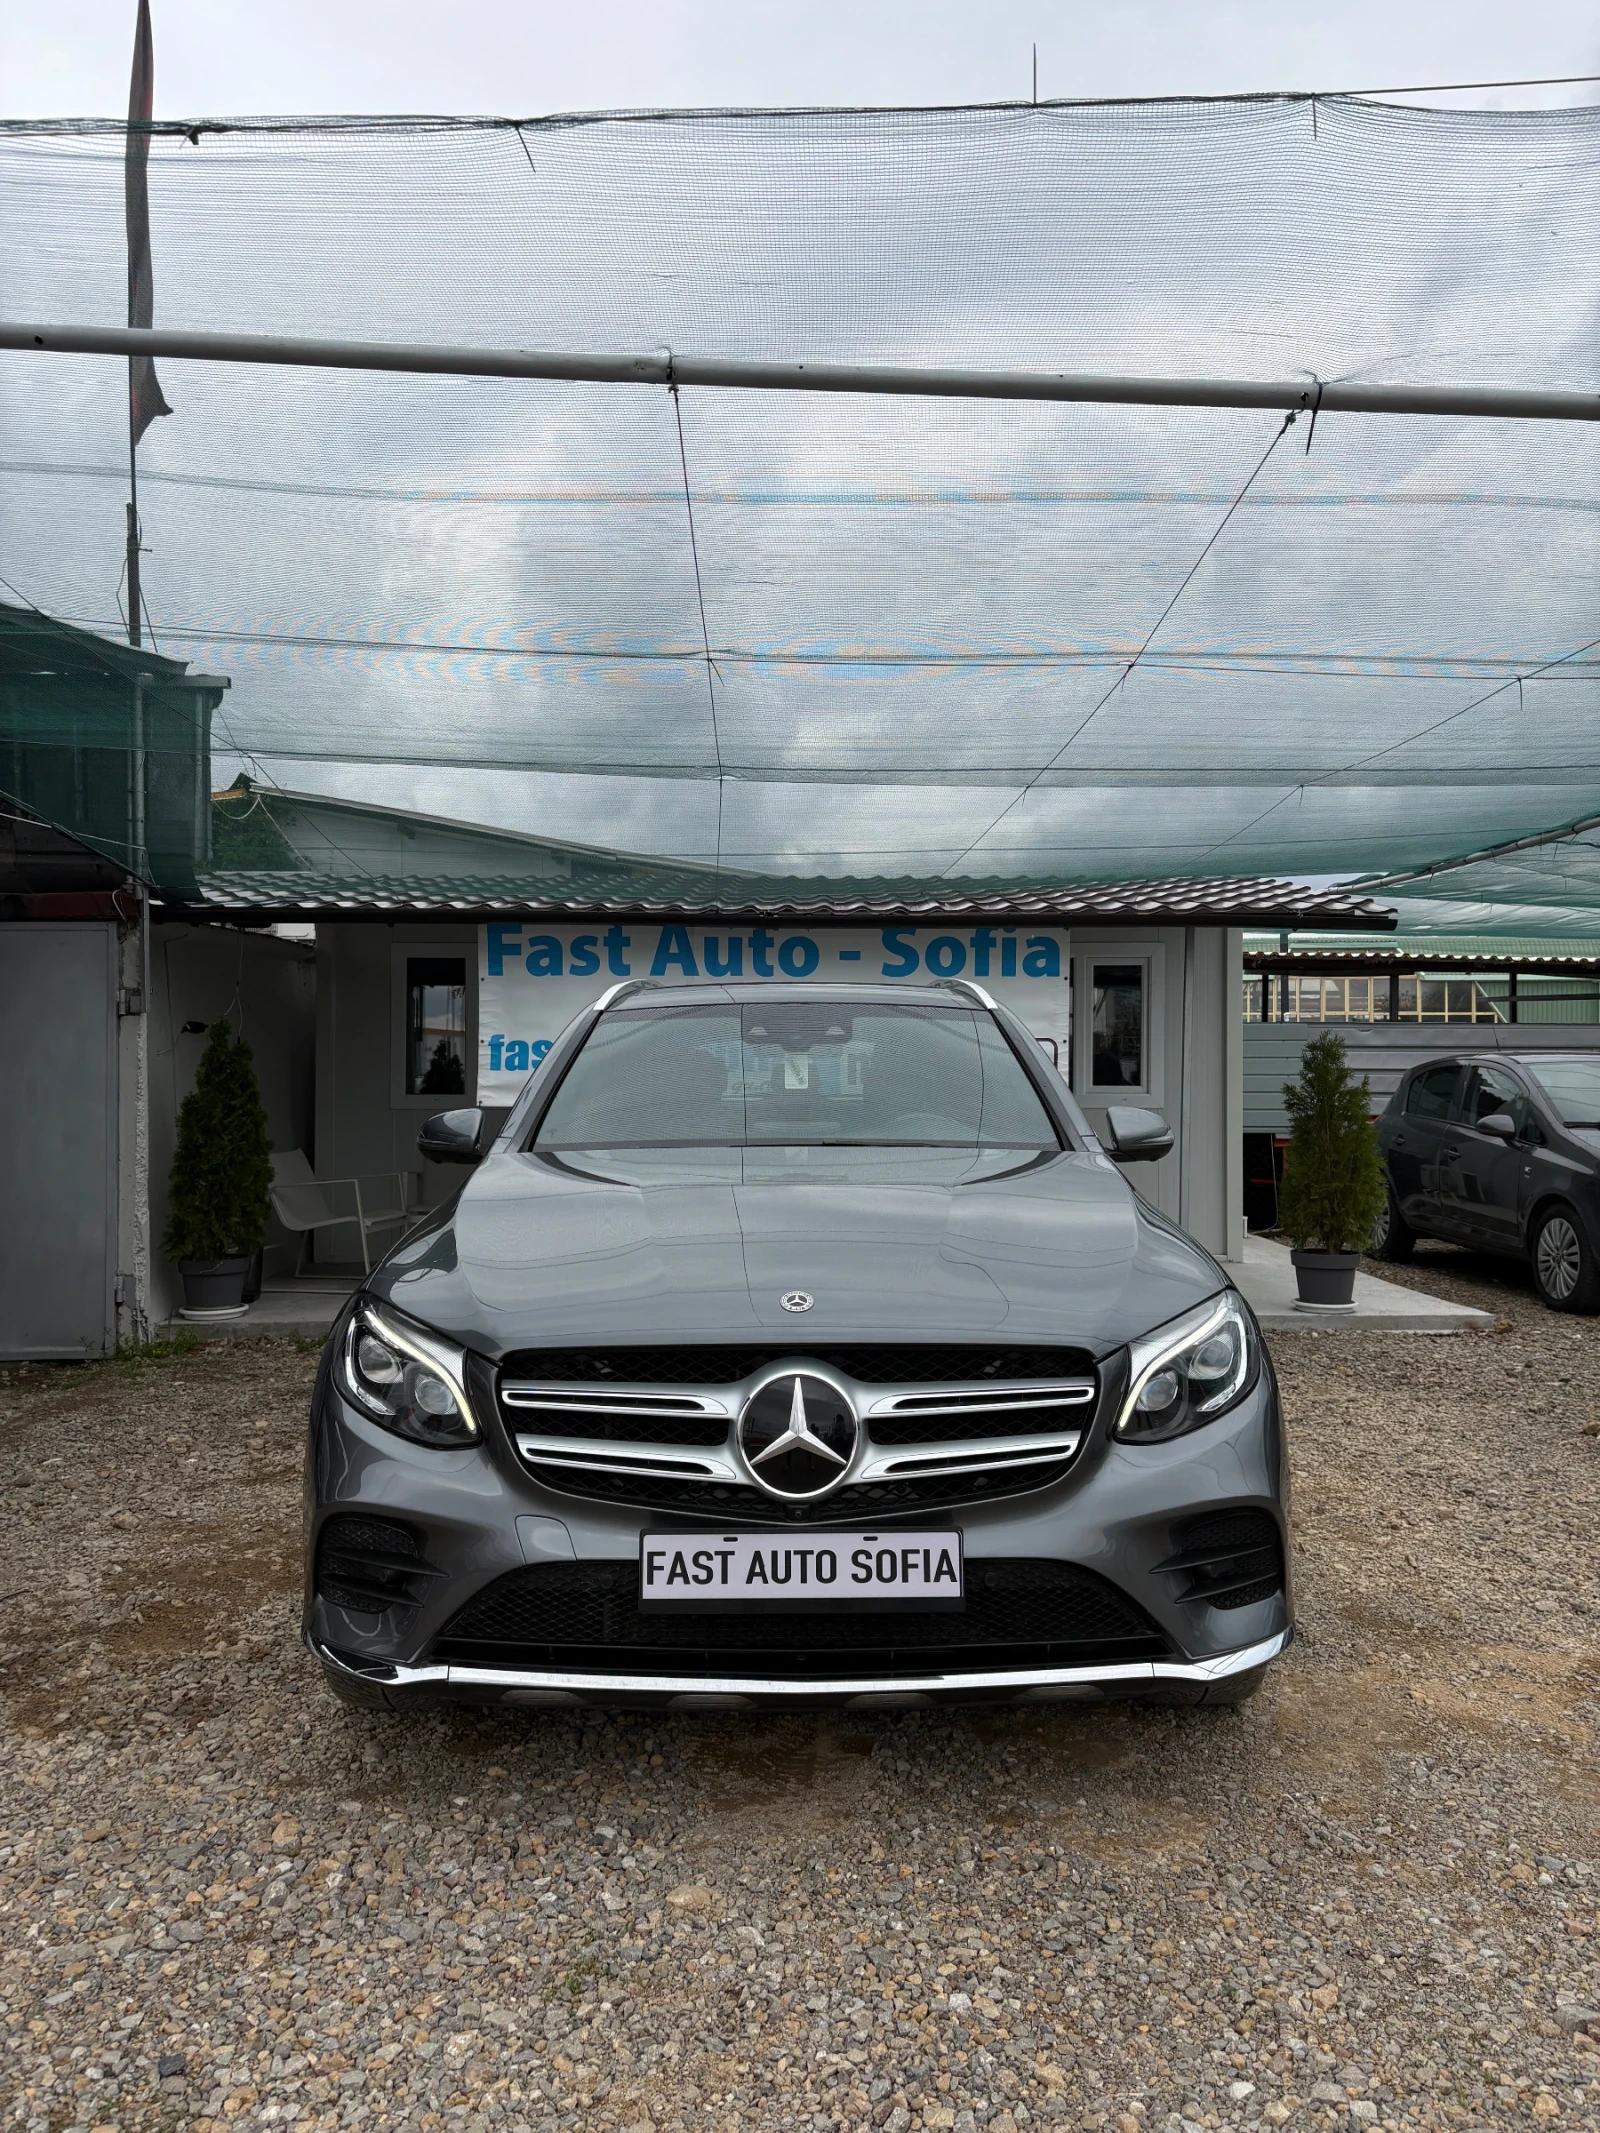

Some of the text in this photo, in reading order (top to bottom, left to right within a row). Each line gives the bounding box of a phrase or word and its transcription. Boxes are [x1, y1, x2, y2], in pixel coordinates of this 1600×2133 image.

[487, 923, 1061, 977] Fast Auto - Sofia
[646, 1549, 958, 1585] FAST AUTO SOFIA
